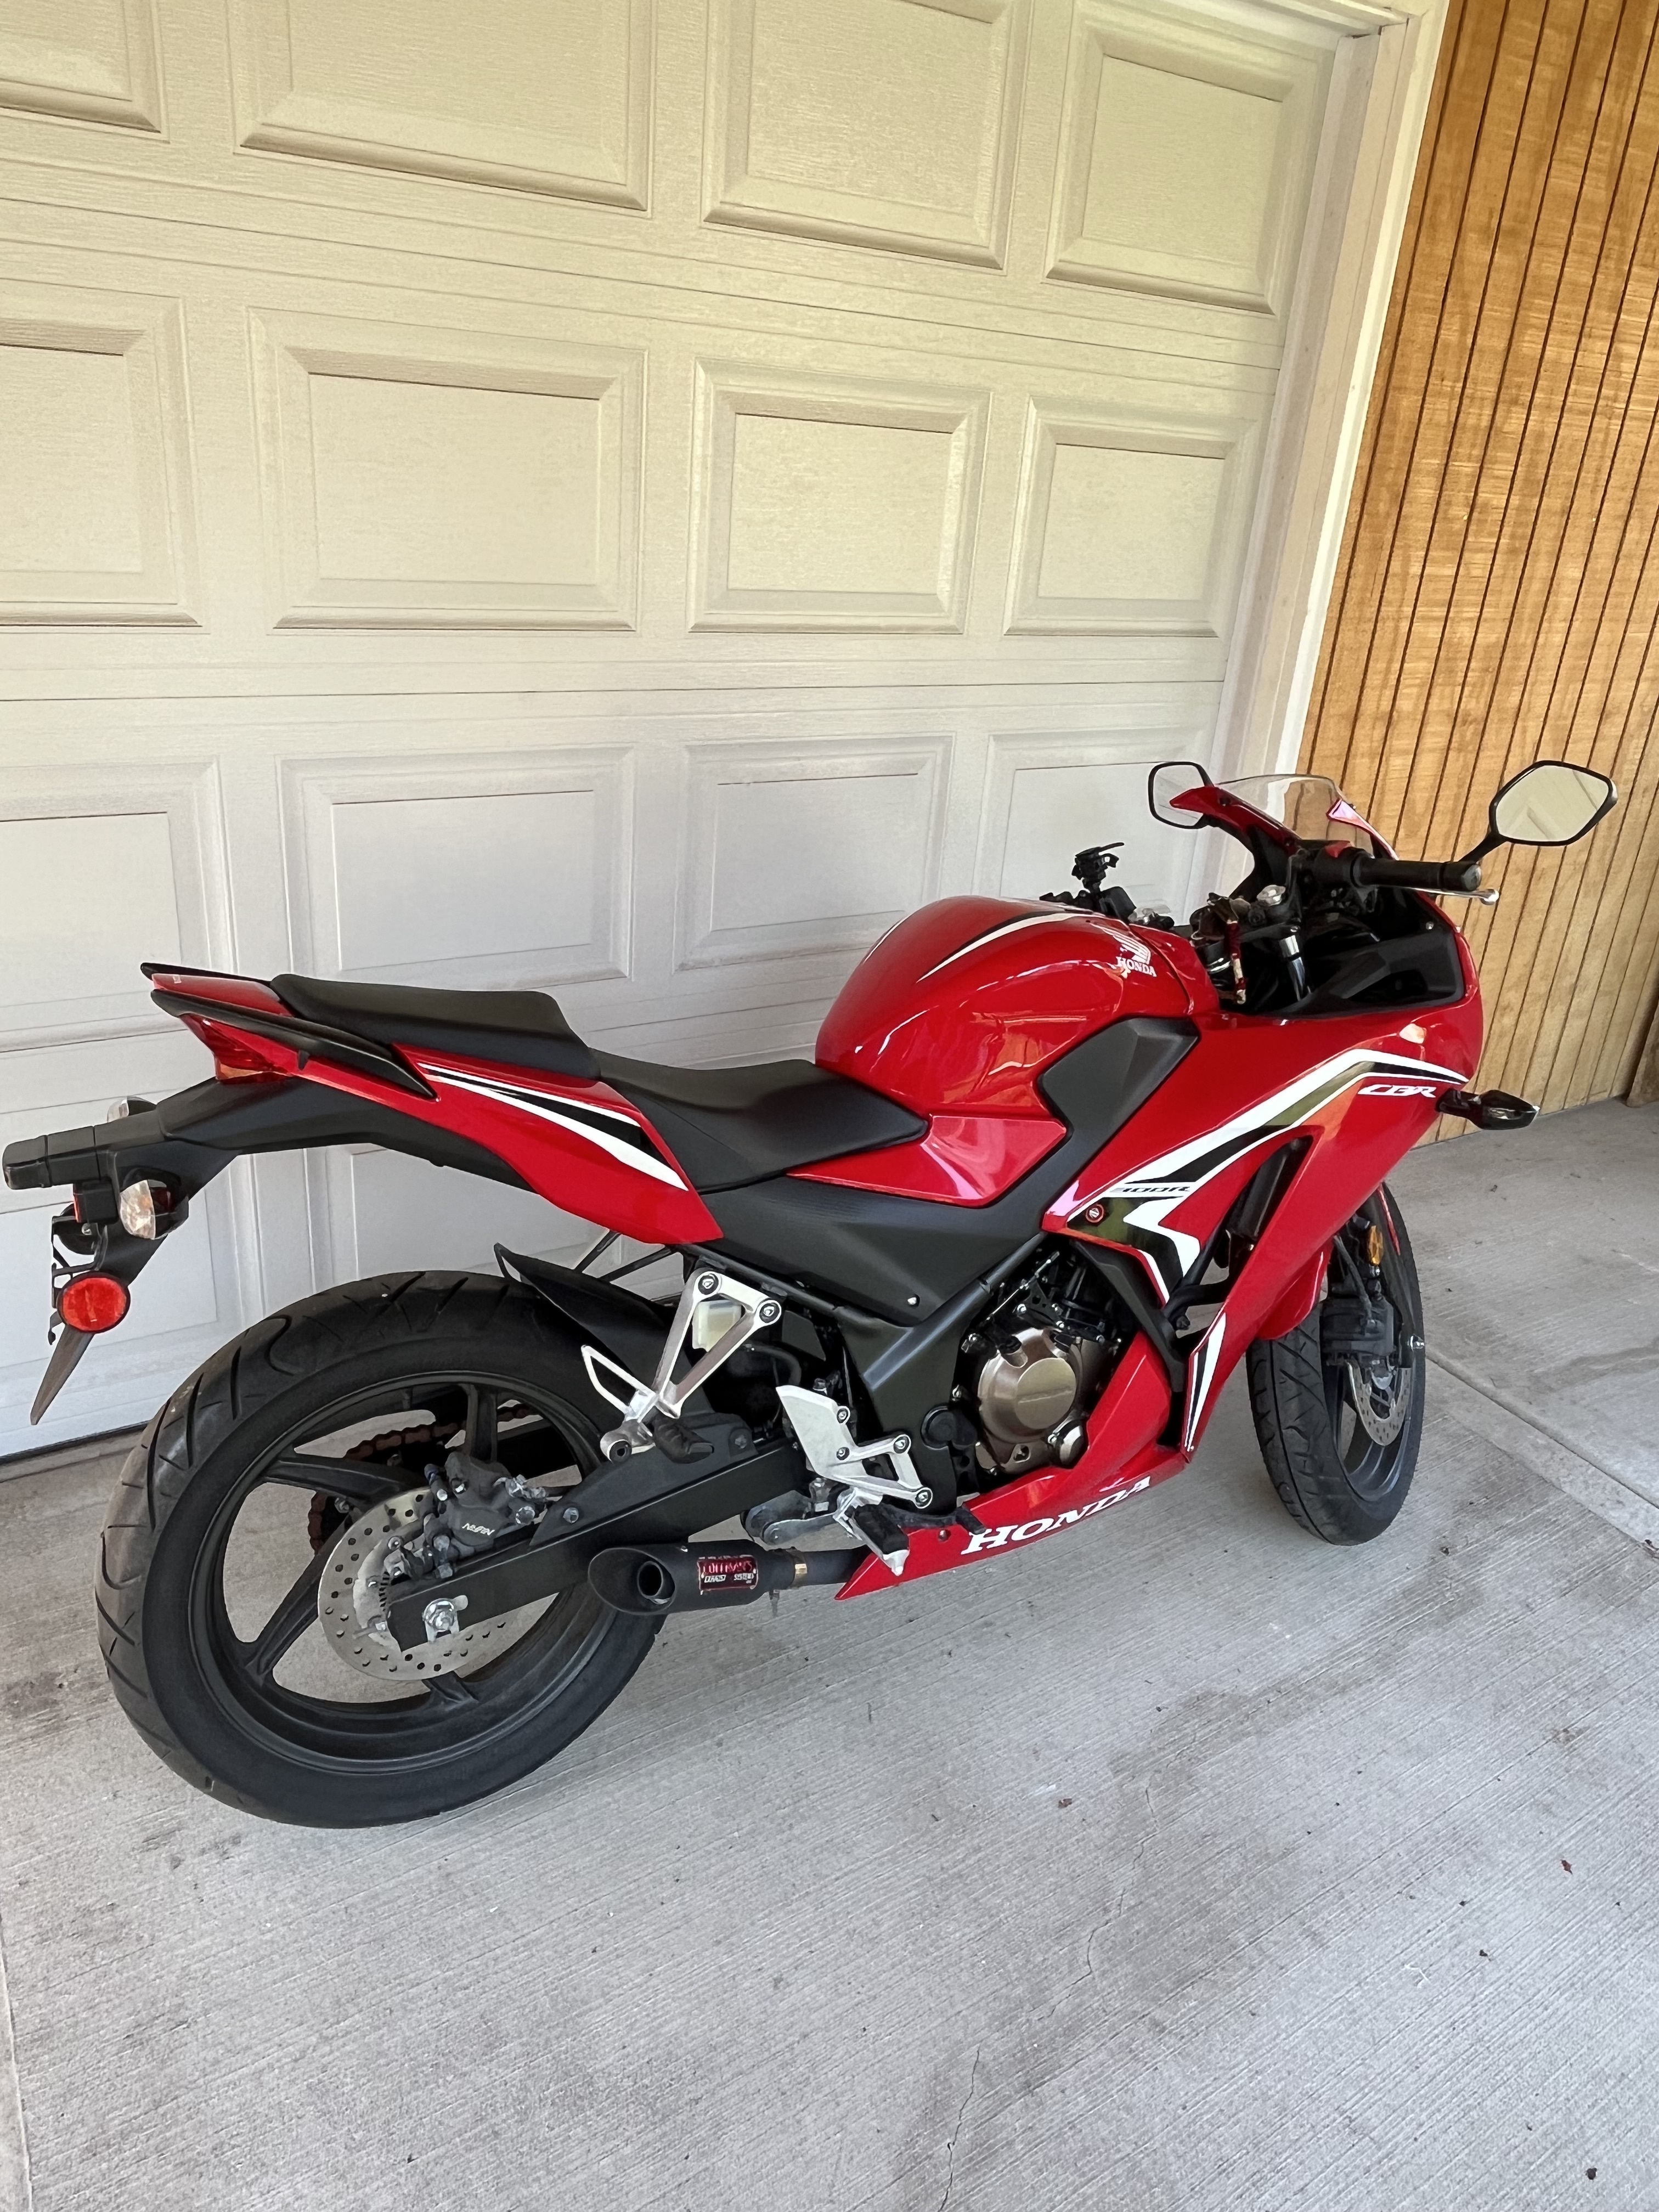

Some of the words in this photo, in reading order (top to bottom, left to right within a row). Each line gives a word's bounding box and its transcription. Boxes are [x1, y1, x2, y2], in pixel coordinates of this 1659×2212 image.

[1115, 956, 1157, 977] HONDA
[1357, 1084, 1436, 1098] CBR
[961, 1476, 1150, 1554] HONDA
